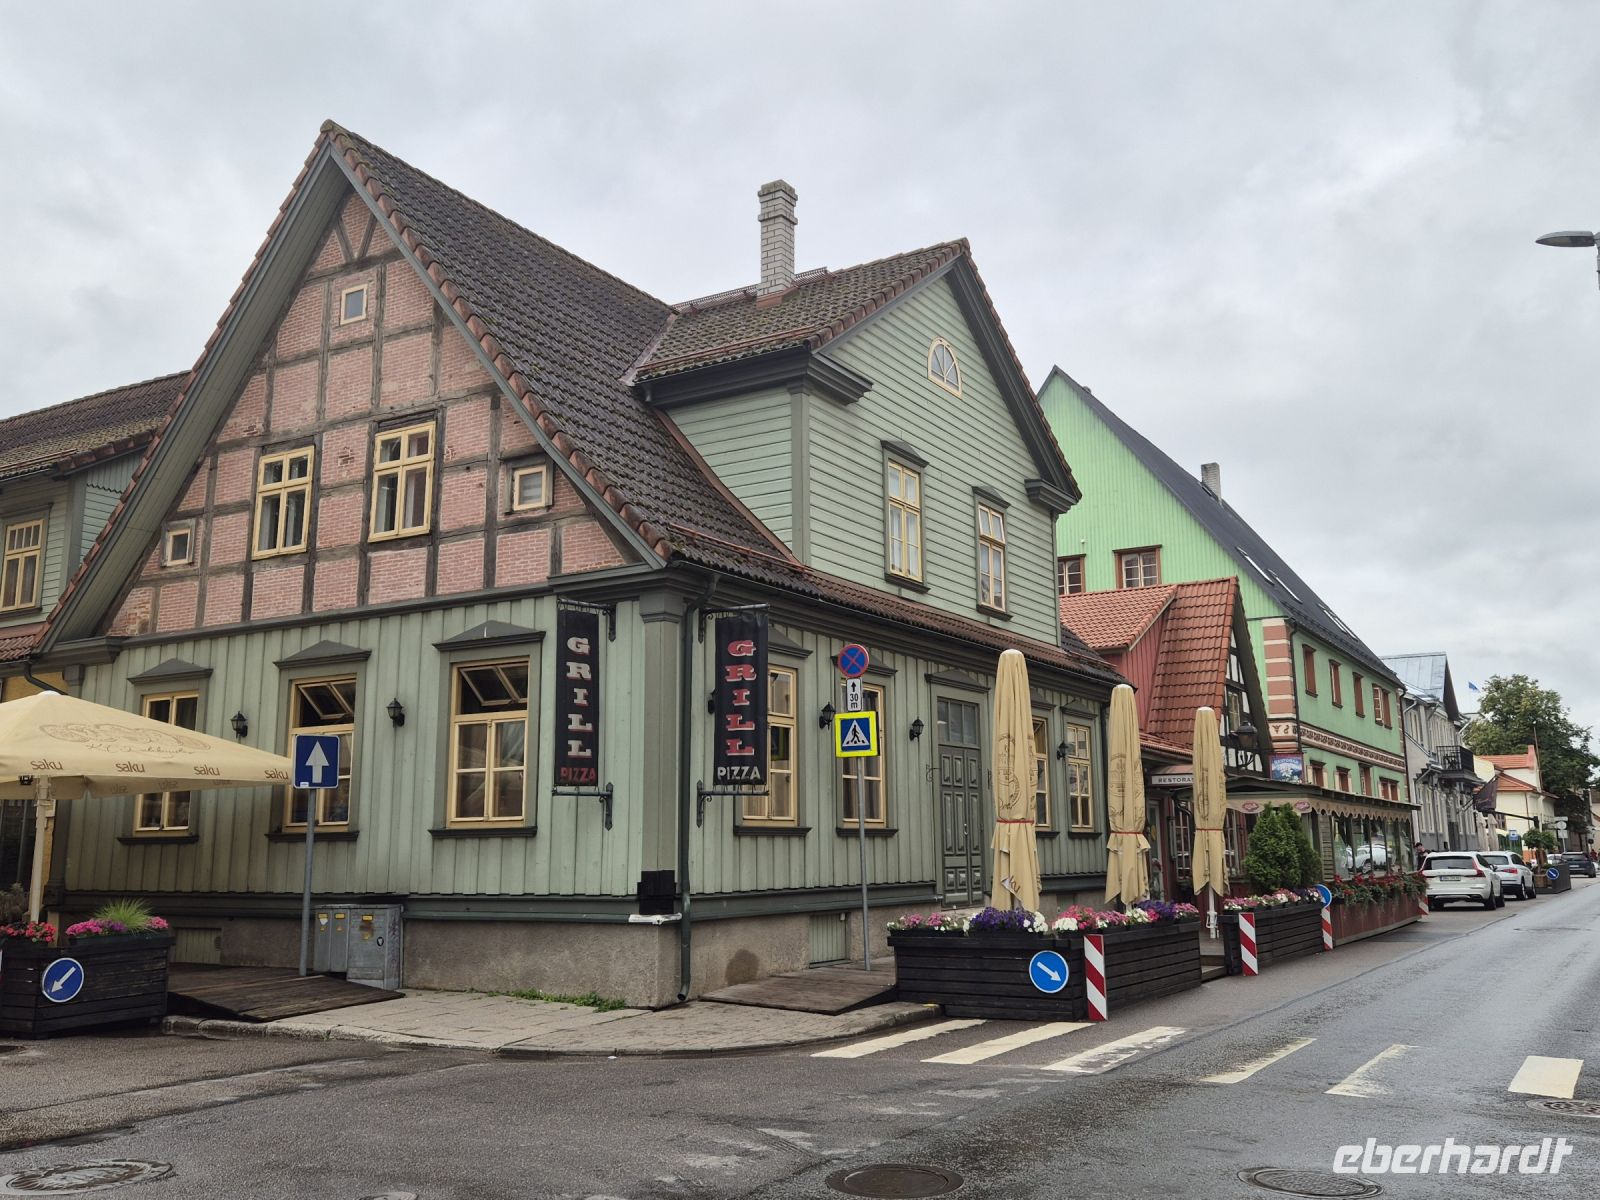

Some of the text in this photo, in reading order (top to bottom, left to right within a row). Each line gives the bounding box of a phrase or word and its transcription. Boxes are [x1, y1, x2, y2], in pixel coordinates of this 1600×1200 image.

[566, 637, 593, 758] GRILL
[725, 640, 757, 756] GRILL
[849, 693, 859, 702] 30
[30, 758, 64, 771] saku
[115, 761, 145, 773] saku
[193, 763, 221, 776] saku
[264, 767, 289, 780] saku
[560, 767, 596, 784] PIZZA
[717, 765, 761, 780] PIZZA
